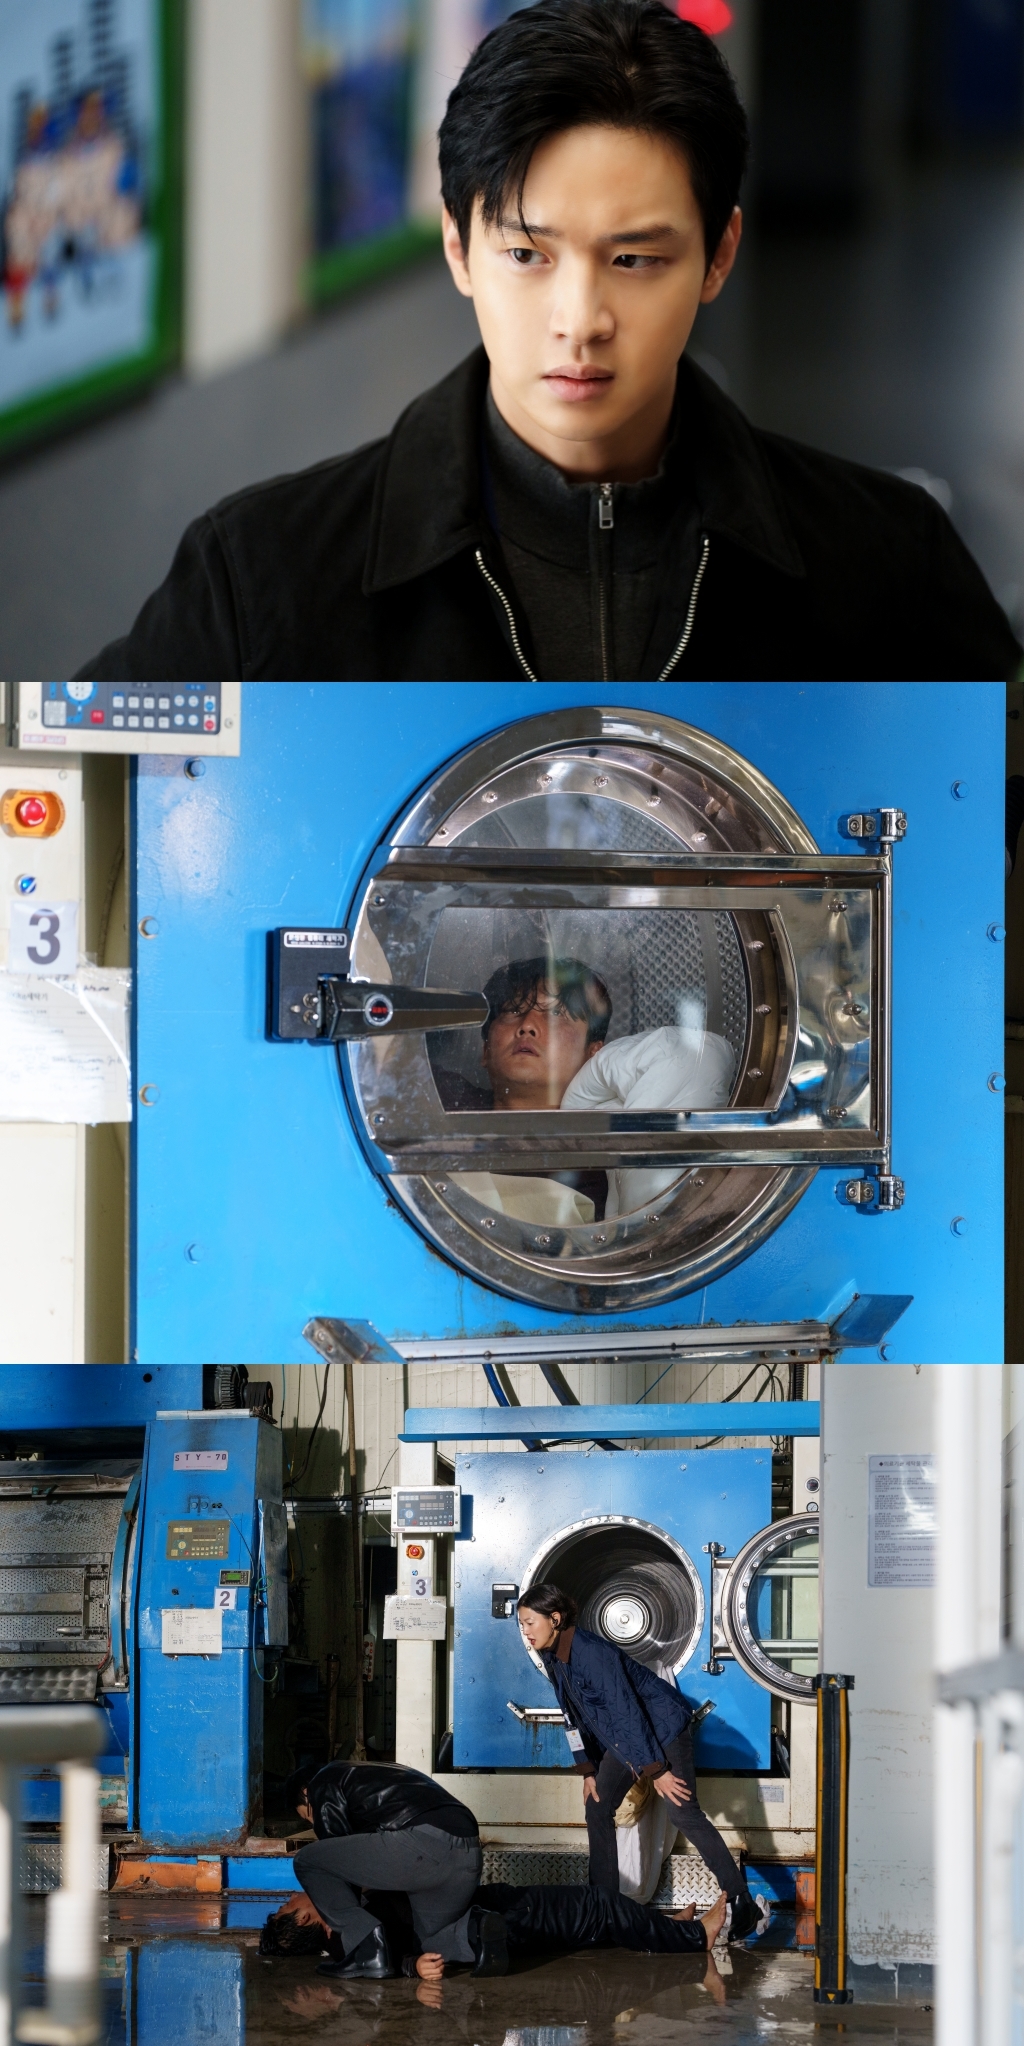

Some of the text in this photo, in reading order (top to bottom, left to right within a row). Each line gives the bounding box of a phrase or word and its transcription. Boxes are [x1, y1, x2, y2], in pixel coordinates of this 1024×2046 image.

[27, 908, 61, 965] 3
[415, 1579, 427, 1596] 3
[219, 1590, 231, 1607] 2
